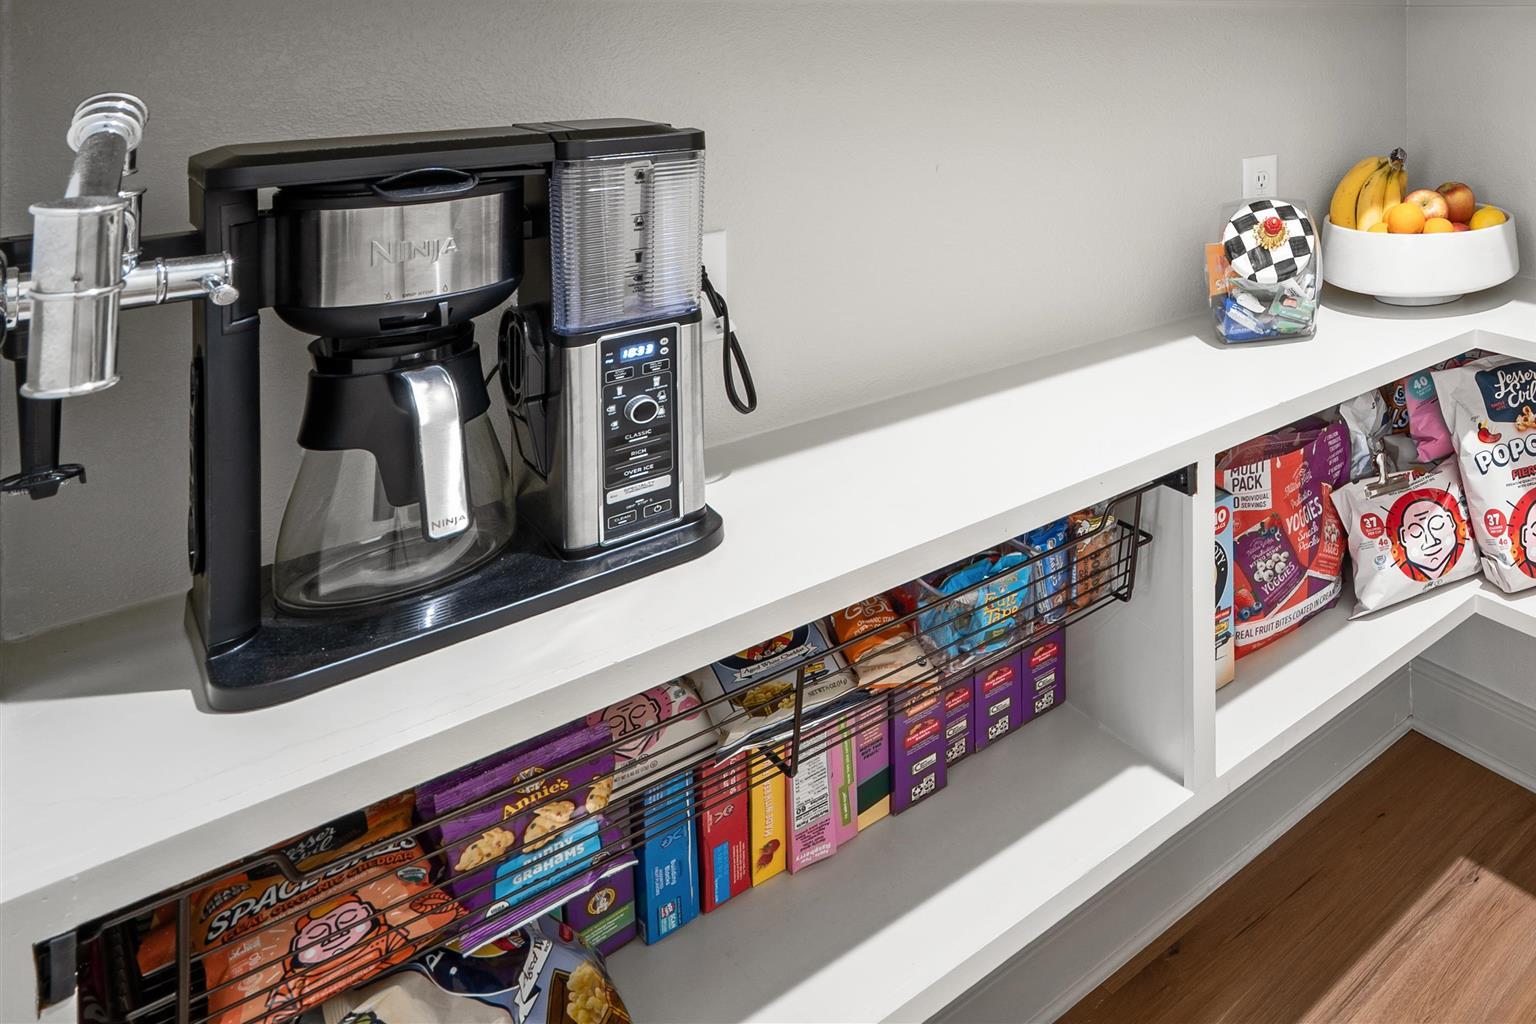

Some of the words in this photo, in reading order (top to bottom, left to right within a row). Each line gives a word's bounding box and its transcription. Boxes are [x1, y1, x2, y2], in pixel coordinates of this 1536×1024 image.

[370, 236, 459, 267] NINJA
[1413, 376, 1428, 389] 40
[624, 429, 653, 441] CLASSIC
[630, 448, 647, 456] RICH
[624, 466, 642, 477] OVER
[1231, 474, 1263, 493] PACK
[1240, 494, 1270, 504] INDIVIDUAL
[1240, 500, 1267, 509] SERVINGS
[431, 513, 467, 532] NINJA
[1285, 495, 1323, 535] YOGGIES
[1362, 517, 1378, 528] 37
[1486, 514, 1501, 527] 37
[1297, 526, 1320, 543] Snack
[1298, 537, 1320, 553] Packs
[1261, 561, 1296, 596] YOGGIES
[1235, 626, 1254, 640] REAL
[1254, 620, 1275, 635] FRUIT
[1275, 612, 1293, 629] BITES
[1293, 602, 1314, 622] COATED
[760, 656, 780, 669] White
[503, 778, 569, 820] Annie's
[347, 851, 416, 877] CHEDDAR
